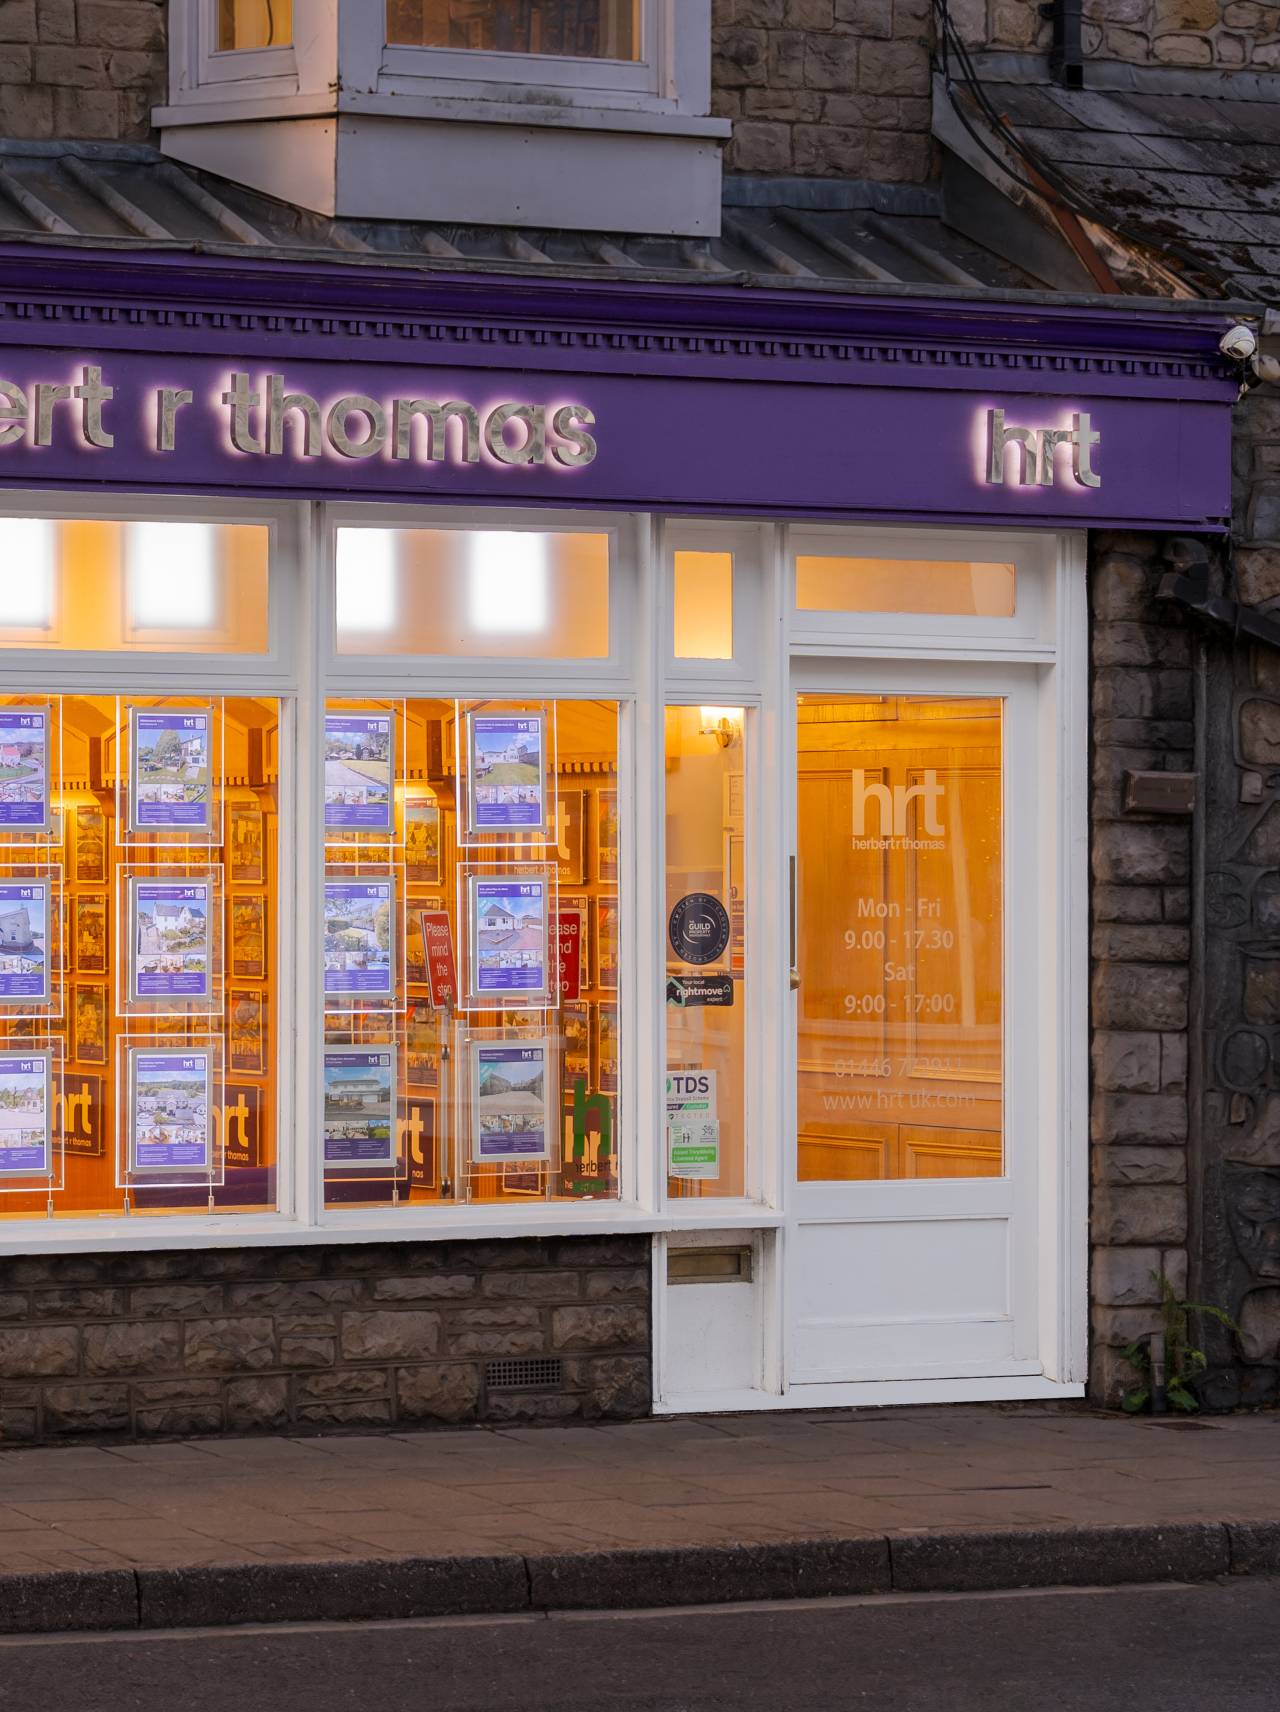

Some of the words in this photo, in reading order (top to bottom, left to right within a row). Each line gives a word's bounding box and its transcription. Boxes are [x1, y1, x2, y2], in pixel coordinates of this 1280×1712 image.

[157, 386, 193, 452] r
[222, 372, 598, 469] thomas
[985, 408, 1101, 488] hrt
[852, 769, 945, 836] hrt
[852, 838, 895, 850] herbert
[902, 838, 945, 850] thomas
[857, 898, 900, 917] Mon
[917, 898, 941, 917] Fri
[426, 923, 449, 937] Please
[548, 923, 577, 935] ease
[844, 930, 885, 949] 9.00
[903, 930, 954, 949] 17.30
[431, 944, 448, 957] mind
[436, 962, 448, 976] the
[884, 962, 915, 981] Sat
[676, 987, 723, 997] rightmove
[844, 995, 885, 1013] 9:00
[903, 994, 954, 1013] 17:00
[673, 1076, 709, 1094] TDS
